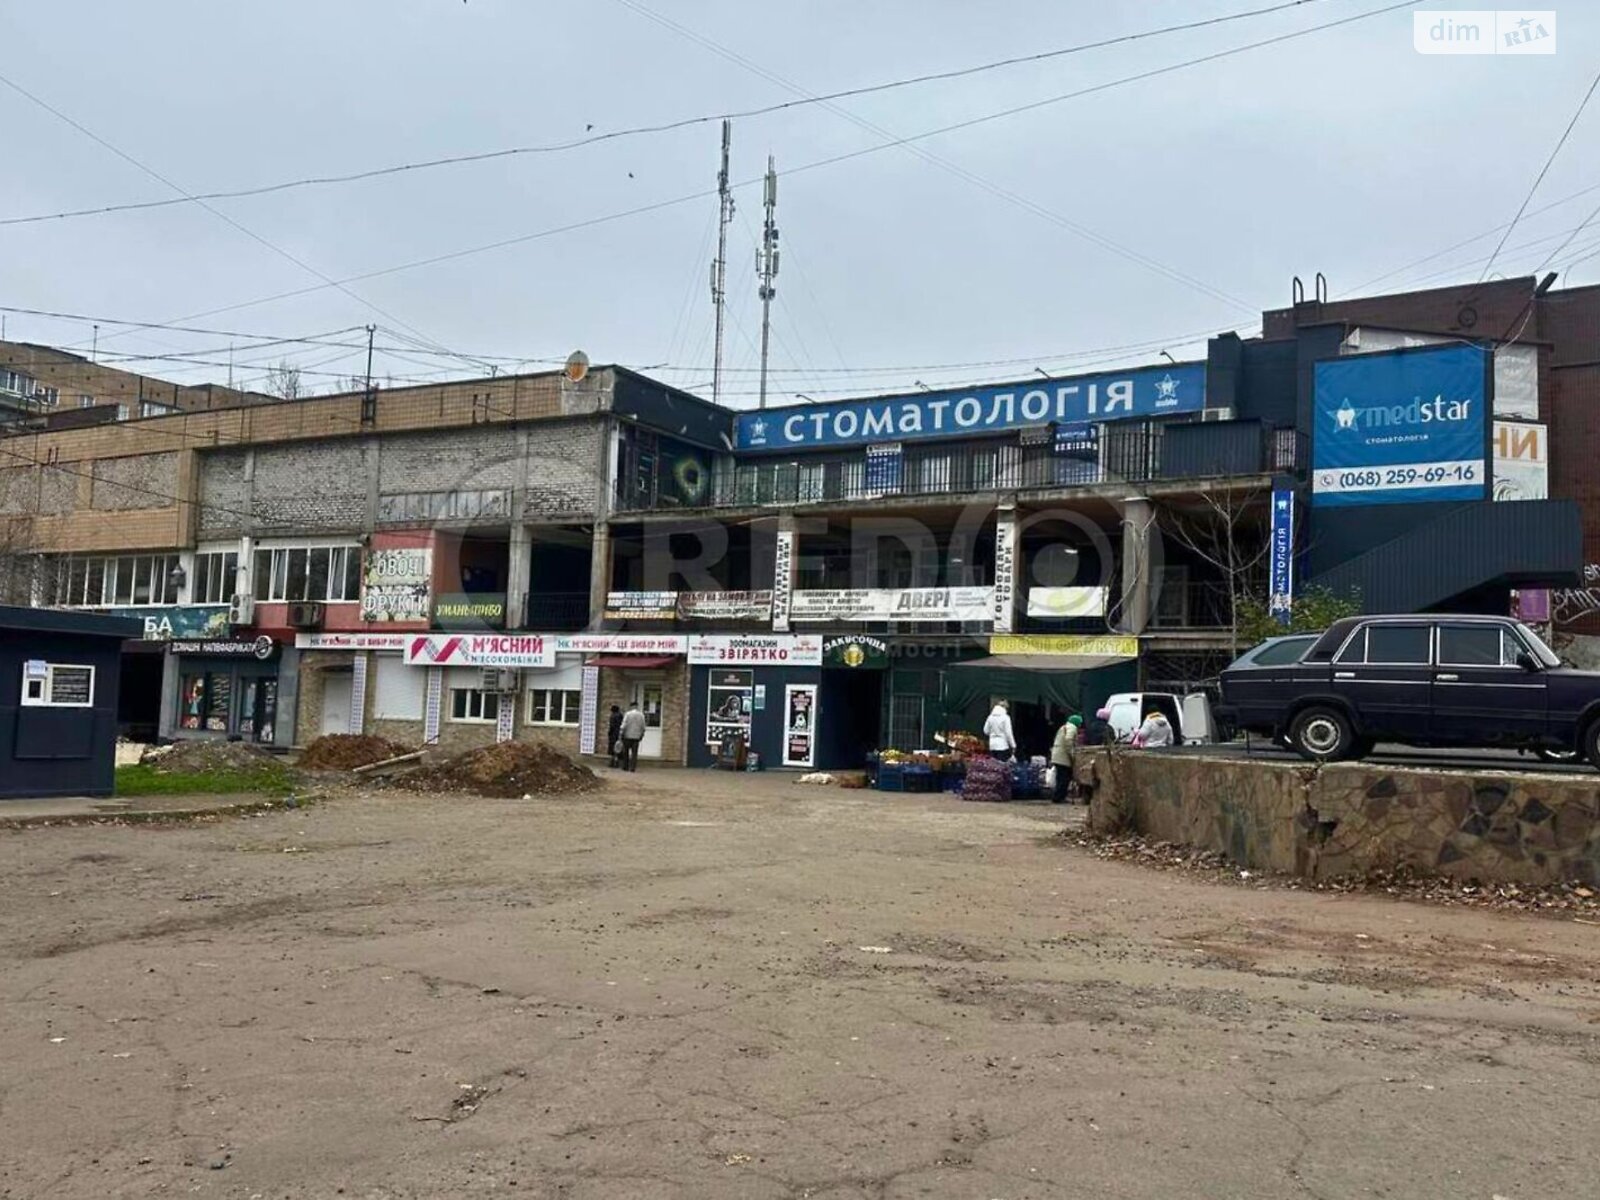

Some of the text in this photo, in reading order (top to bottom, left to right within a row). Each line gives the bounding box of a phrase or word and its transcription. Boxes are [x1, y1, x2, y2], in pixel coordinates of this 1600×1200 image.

[783, 380, 1134, 443] СТОМАТОЛОГІЯ
[1365, 394, 1471, 428] medstar
[1365, 433, 1429, 445] стоматологія
[1339, 466, 1474, 488] (068) 259-69-16
[377, 556, 425, 576] ОВОЧІ
[363, 595, 428, 611] ФРУКТИ
[897, 591, 950, 610] ДВЕРІ
[729, 640, 778, 648] ЗООМАГАЗИН
[824, 635, 887, 652] ЗАКУСОЧНА
[719, 648, 788, 660] ЗВІРЯТКО
